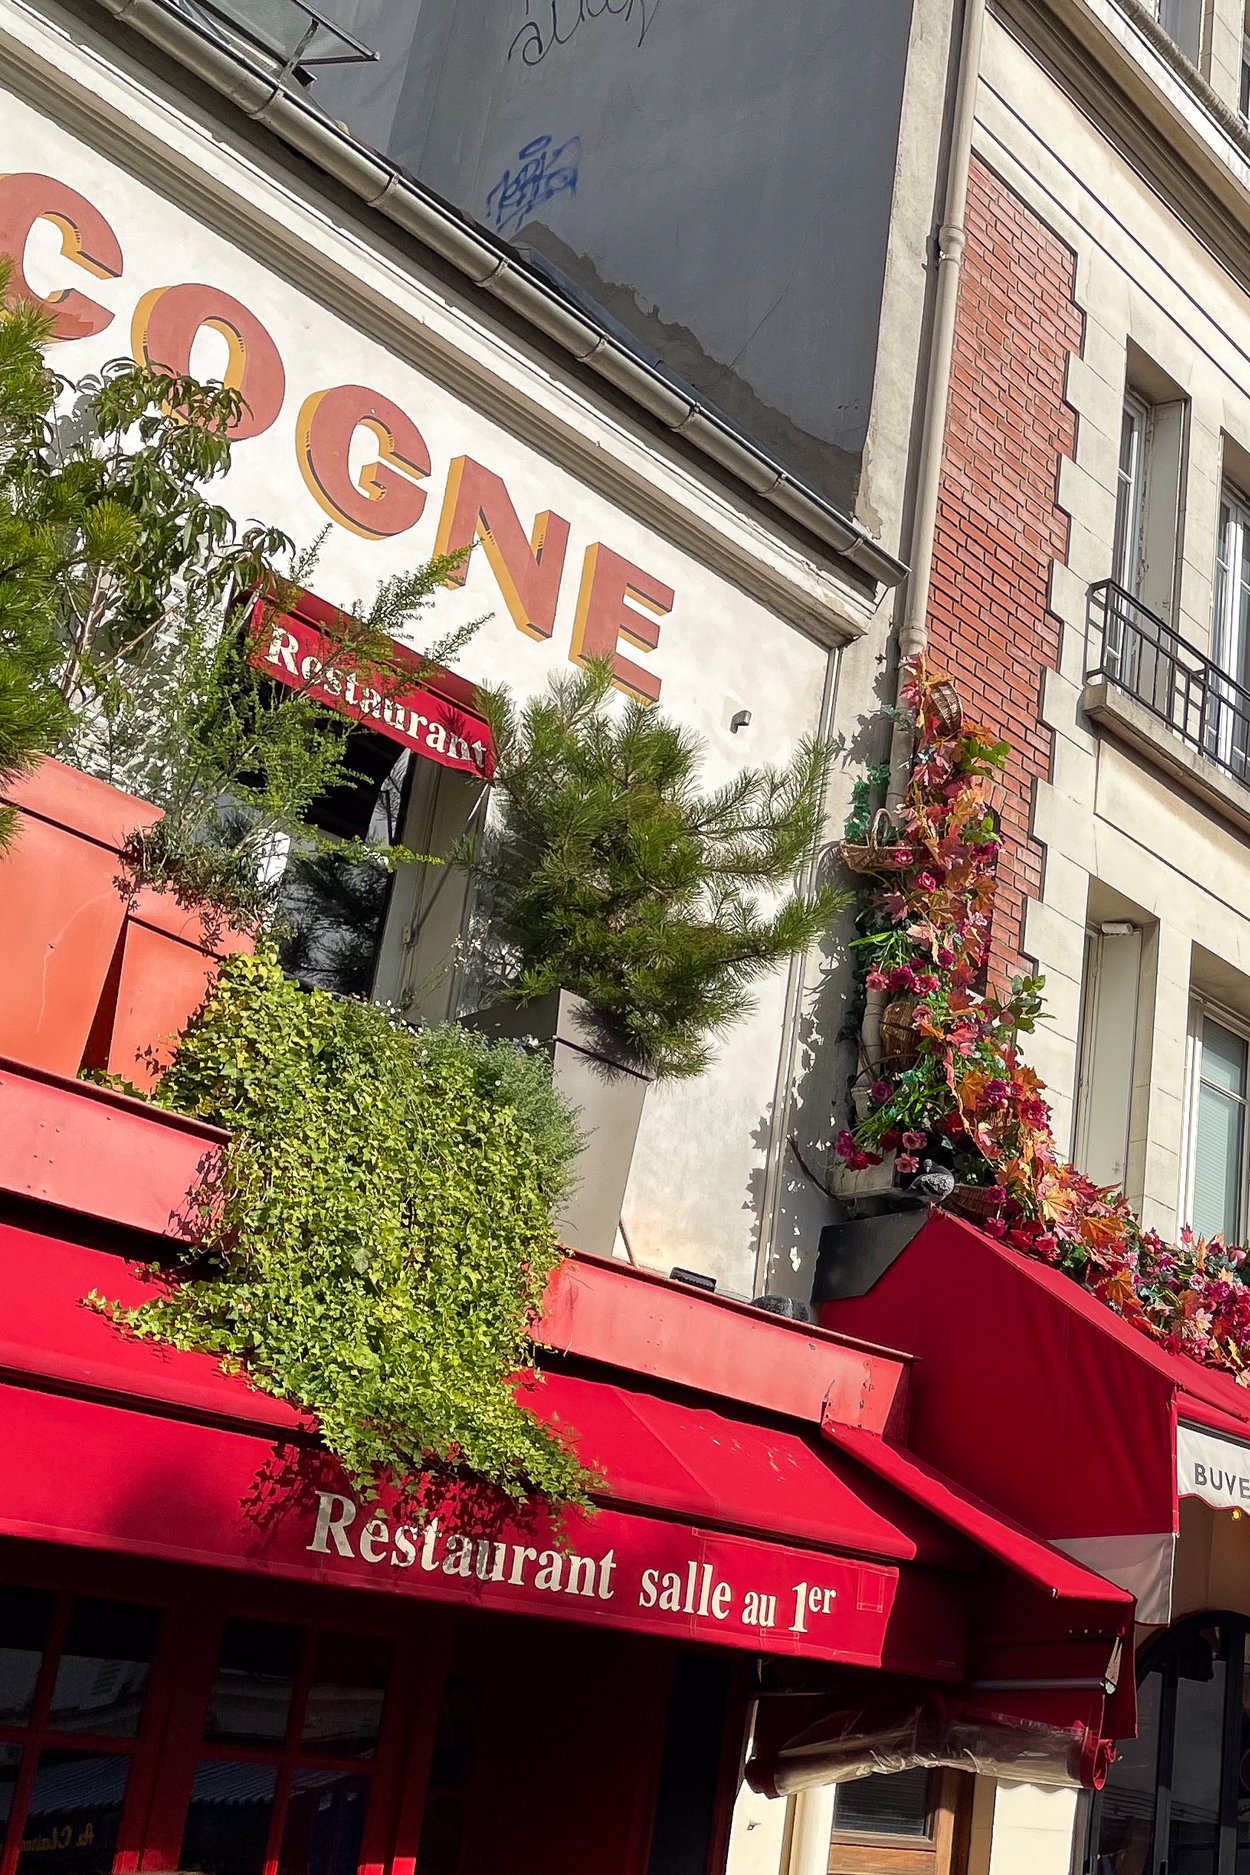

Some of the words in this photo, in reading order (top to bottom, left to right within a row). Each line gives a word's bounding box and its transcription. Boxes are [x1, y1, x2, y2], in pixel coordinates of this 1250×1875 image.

[0, 172, 675, 705] COGNE
[264, 624, 487, 768] Restaurant
[306, 1491, 617, 1600] Restaurant
[638, 1560, 732, 1620] salle
[741, 1591, 777, 1628] au
[788, 1581, 837, 1633] 1er
